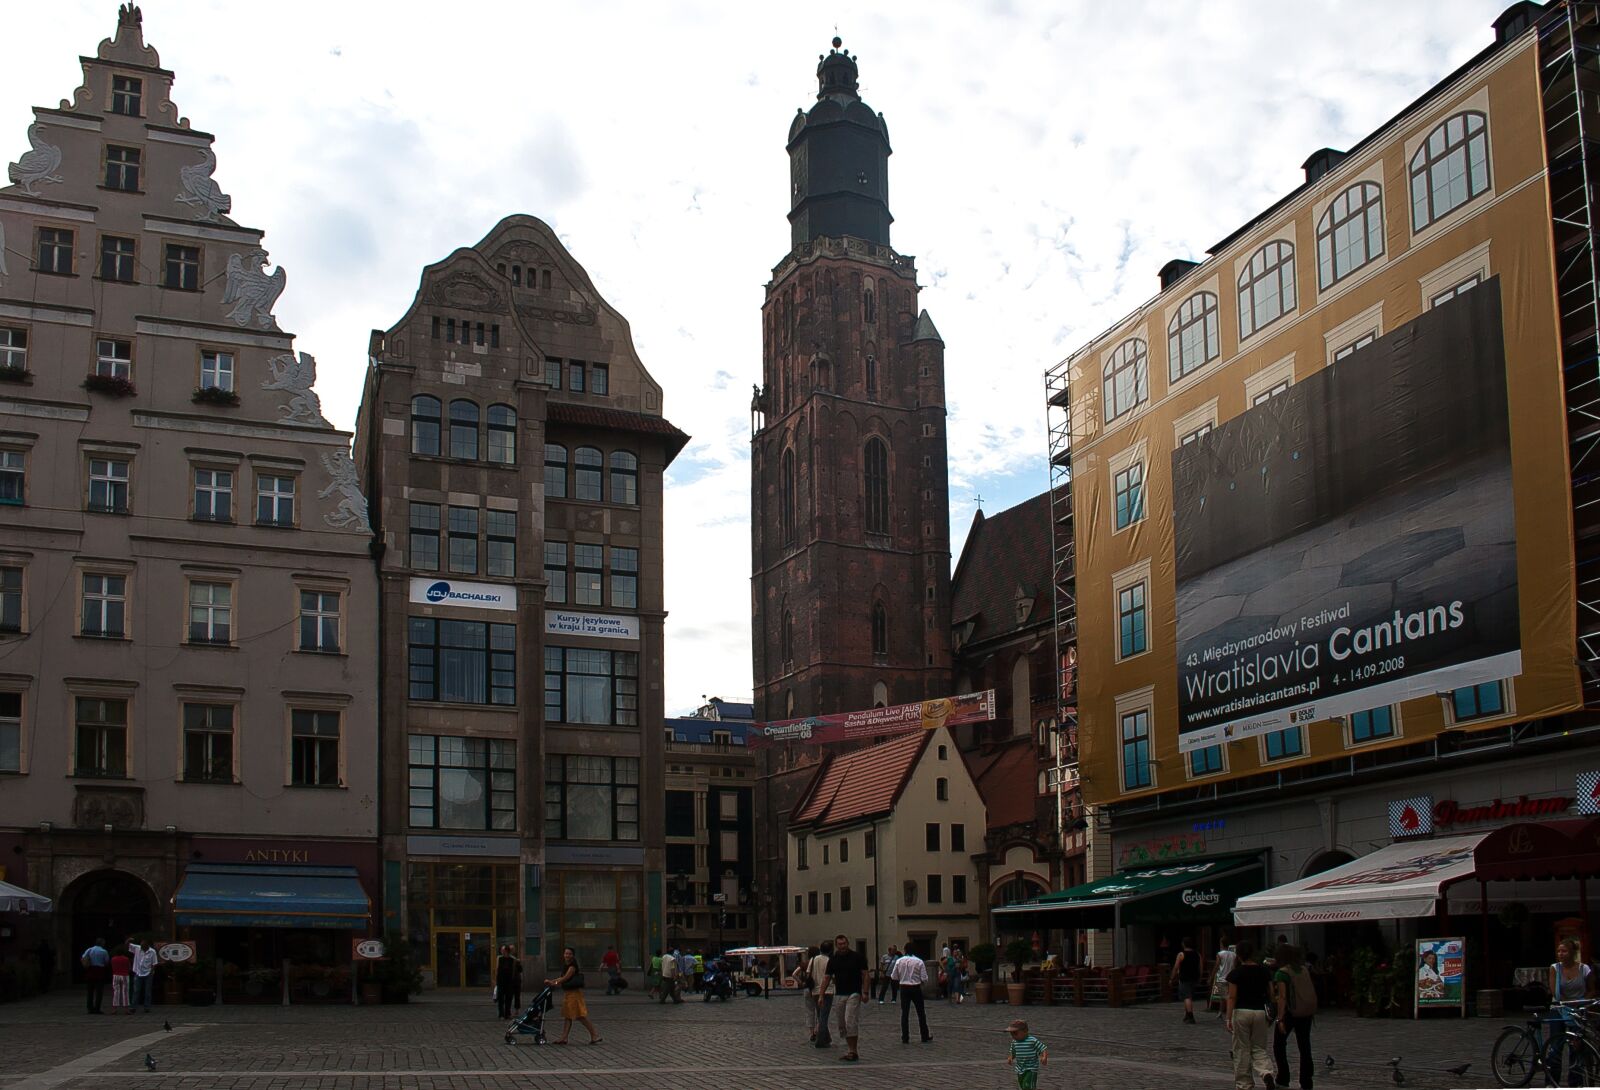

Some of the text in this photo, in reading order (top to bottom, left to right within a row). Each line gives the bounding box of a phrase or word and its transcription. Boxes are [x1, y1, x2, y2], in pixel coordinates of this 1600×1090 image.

[449, 592, 501, 602] BACHALSKI
[557, 614, 621, 626] Kursy językowe
[559, 622, 580, 631] kraju
[598, 626, 629, 635] granicą
[1186, 602, 1350, 668] 43. Międzynarodowy Festiwal
[1186, 600, 1464, 702] Wratislavia Cantans
[1332, 673, 1339, 686] 4
[1350, 656, 1405, 682] 14.09.2008
[1187, 676, 1320, 723] www.wratislaviacantans.pl
[848, 711, 884, 721] Pendulum
[885, 707, 900, 716] Live
[763, 723, 811, 736] Creamfields
[844, 719, 866, 728] Sasha
[1433, 795, 1575, 826] Dominium
[245, 849, 308, 863] ANTYKI
[1182, 888, 1221, 907] Carlsberg
[1290, 910, 1360, 921] Dominium
